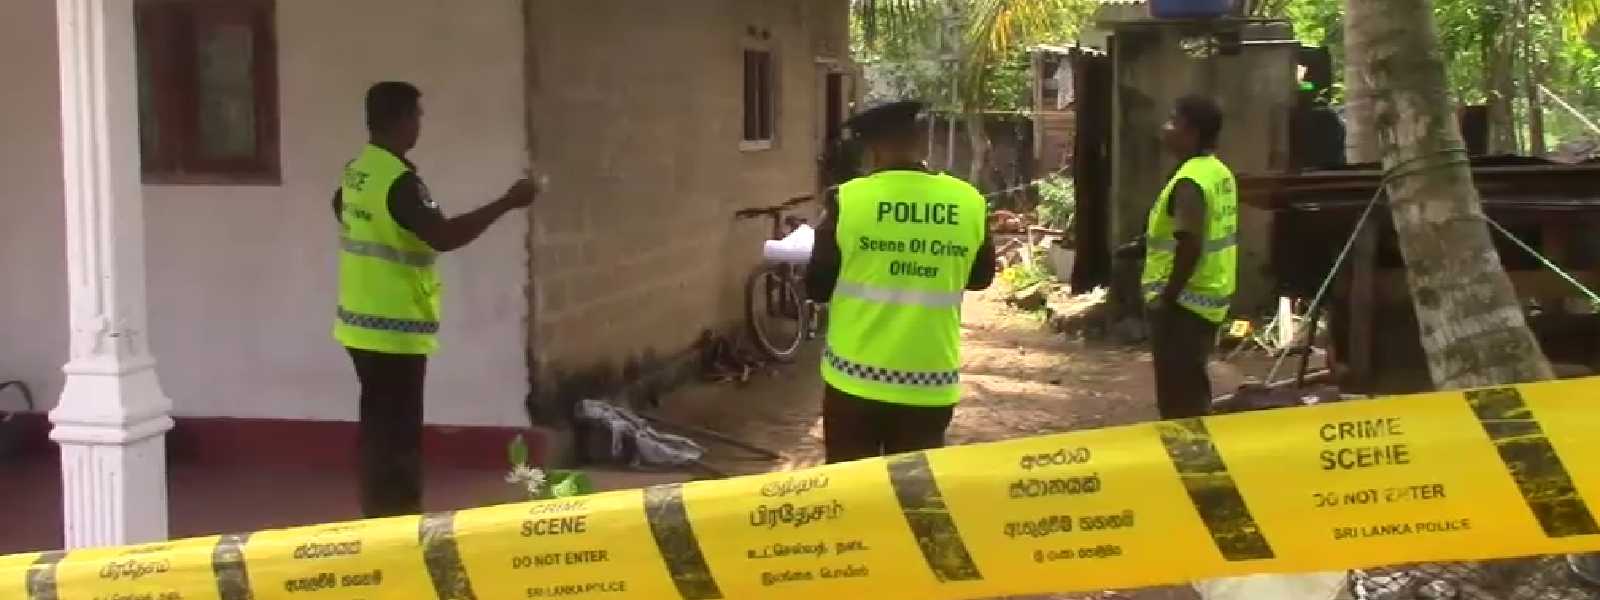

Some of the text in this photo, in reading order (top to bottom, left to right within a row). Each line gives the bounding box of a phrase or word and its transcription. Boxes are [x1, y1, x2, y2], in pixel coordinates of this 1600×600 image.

[877, 202, 960, 224] POLICE
[859, 236, 905, 253] Scene
[930, 240, 968, 257] Crime
[890, 260, 939, 277] Officer
[1319, 417, 1403, 442] CRIME
[1319, 444, 1410, 470] SCENE
[1343, 489, 1378, 505] NOT
[520, 515, 587, 537] SCENE
[1333, 518, 1472, 540] SRI LANKA POLICE
[512, 550, 609, 569] DO NOT ENTER
[585, 581, 627, 593] POLICE
